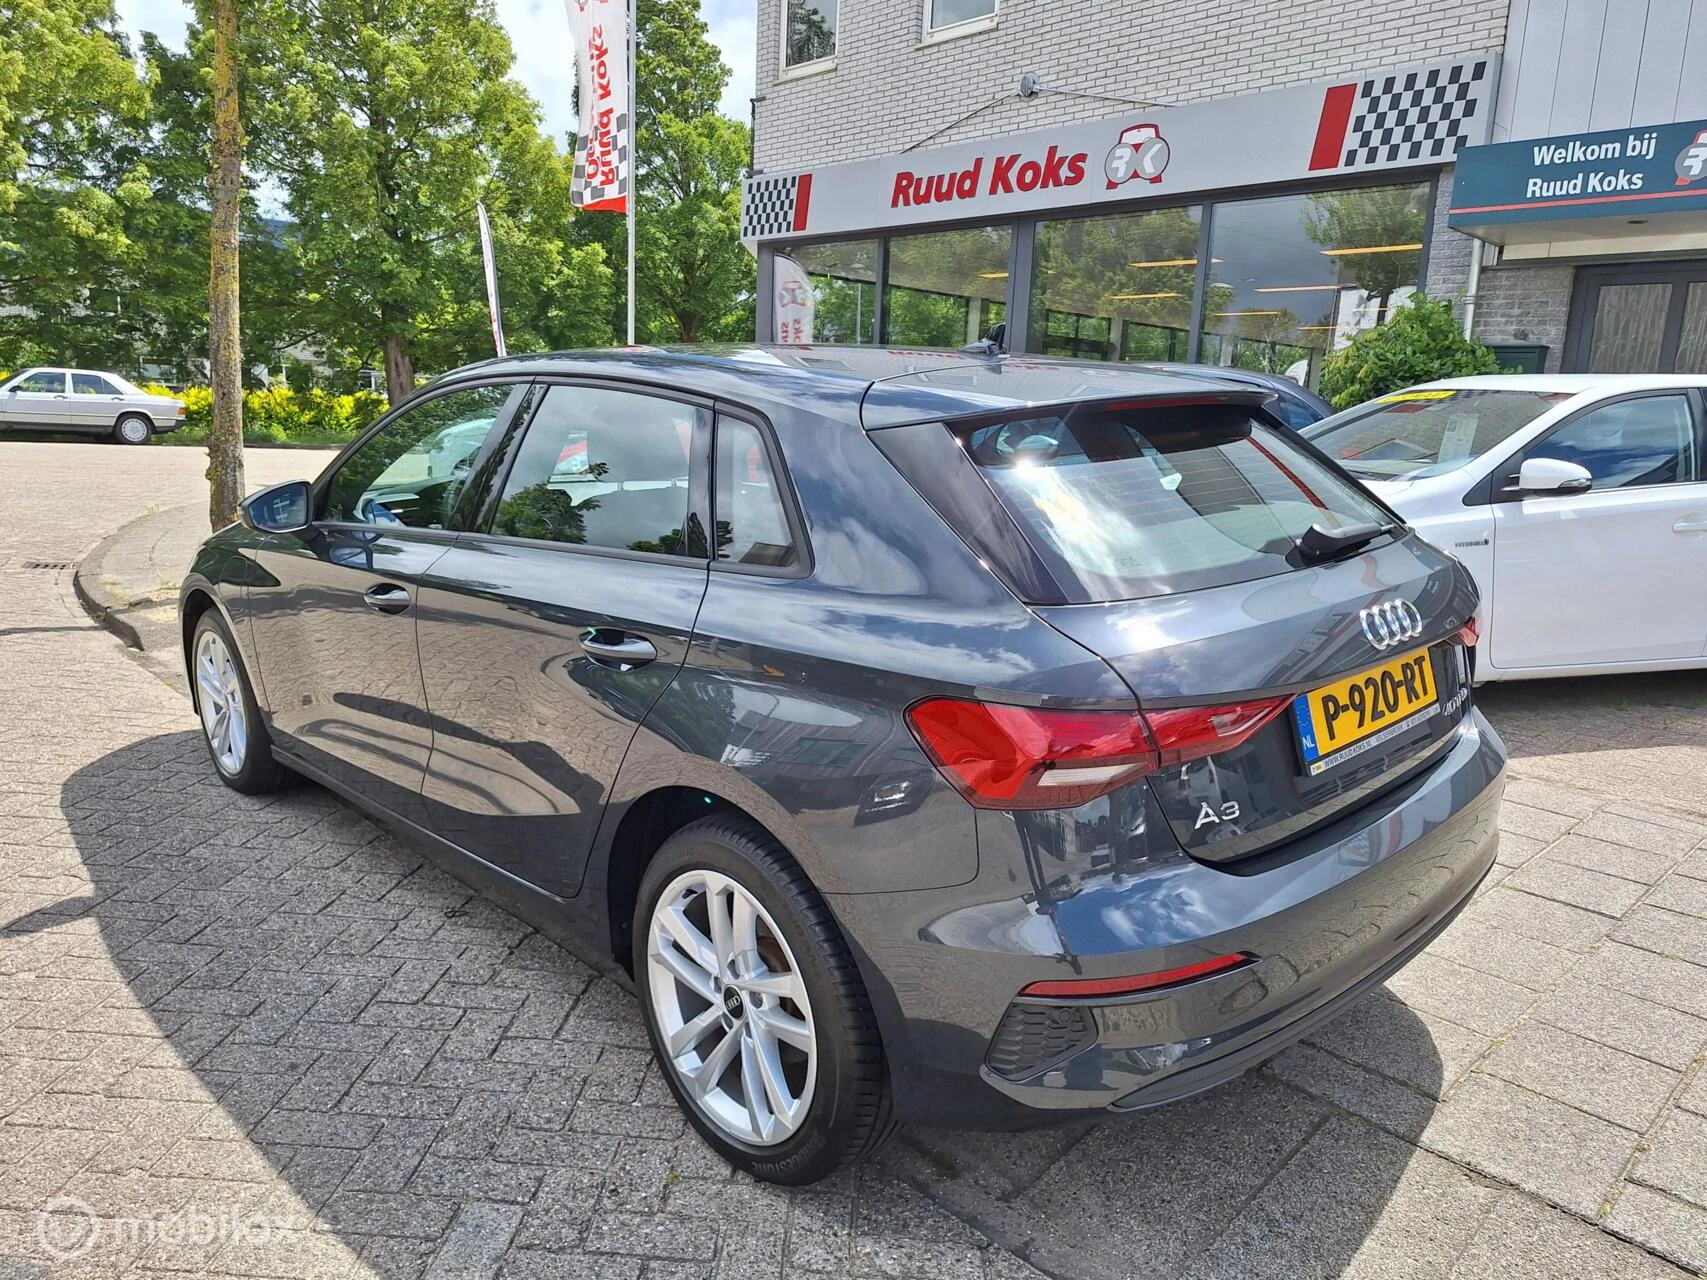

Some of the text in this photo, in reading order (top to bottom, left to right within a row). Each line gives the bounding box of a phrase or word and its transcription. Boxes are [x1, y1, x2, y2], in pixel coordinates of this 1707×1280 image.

[1532, 132, 1658, 166] Welkom bij
[890, 145, 1089, 209] Ruud Koks
[1526, 169, 1644, 199] Ruud Koks
[1320, 655, 1429, 741] P-920-RT
[1302, 735, 1316, 751] NL
[1194, 800, 1240, 830] A3
